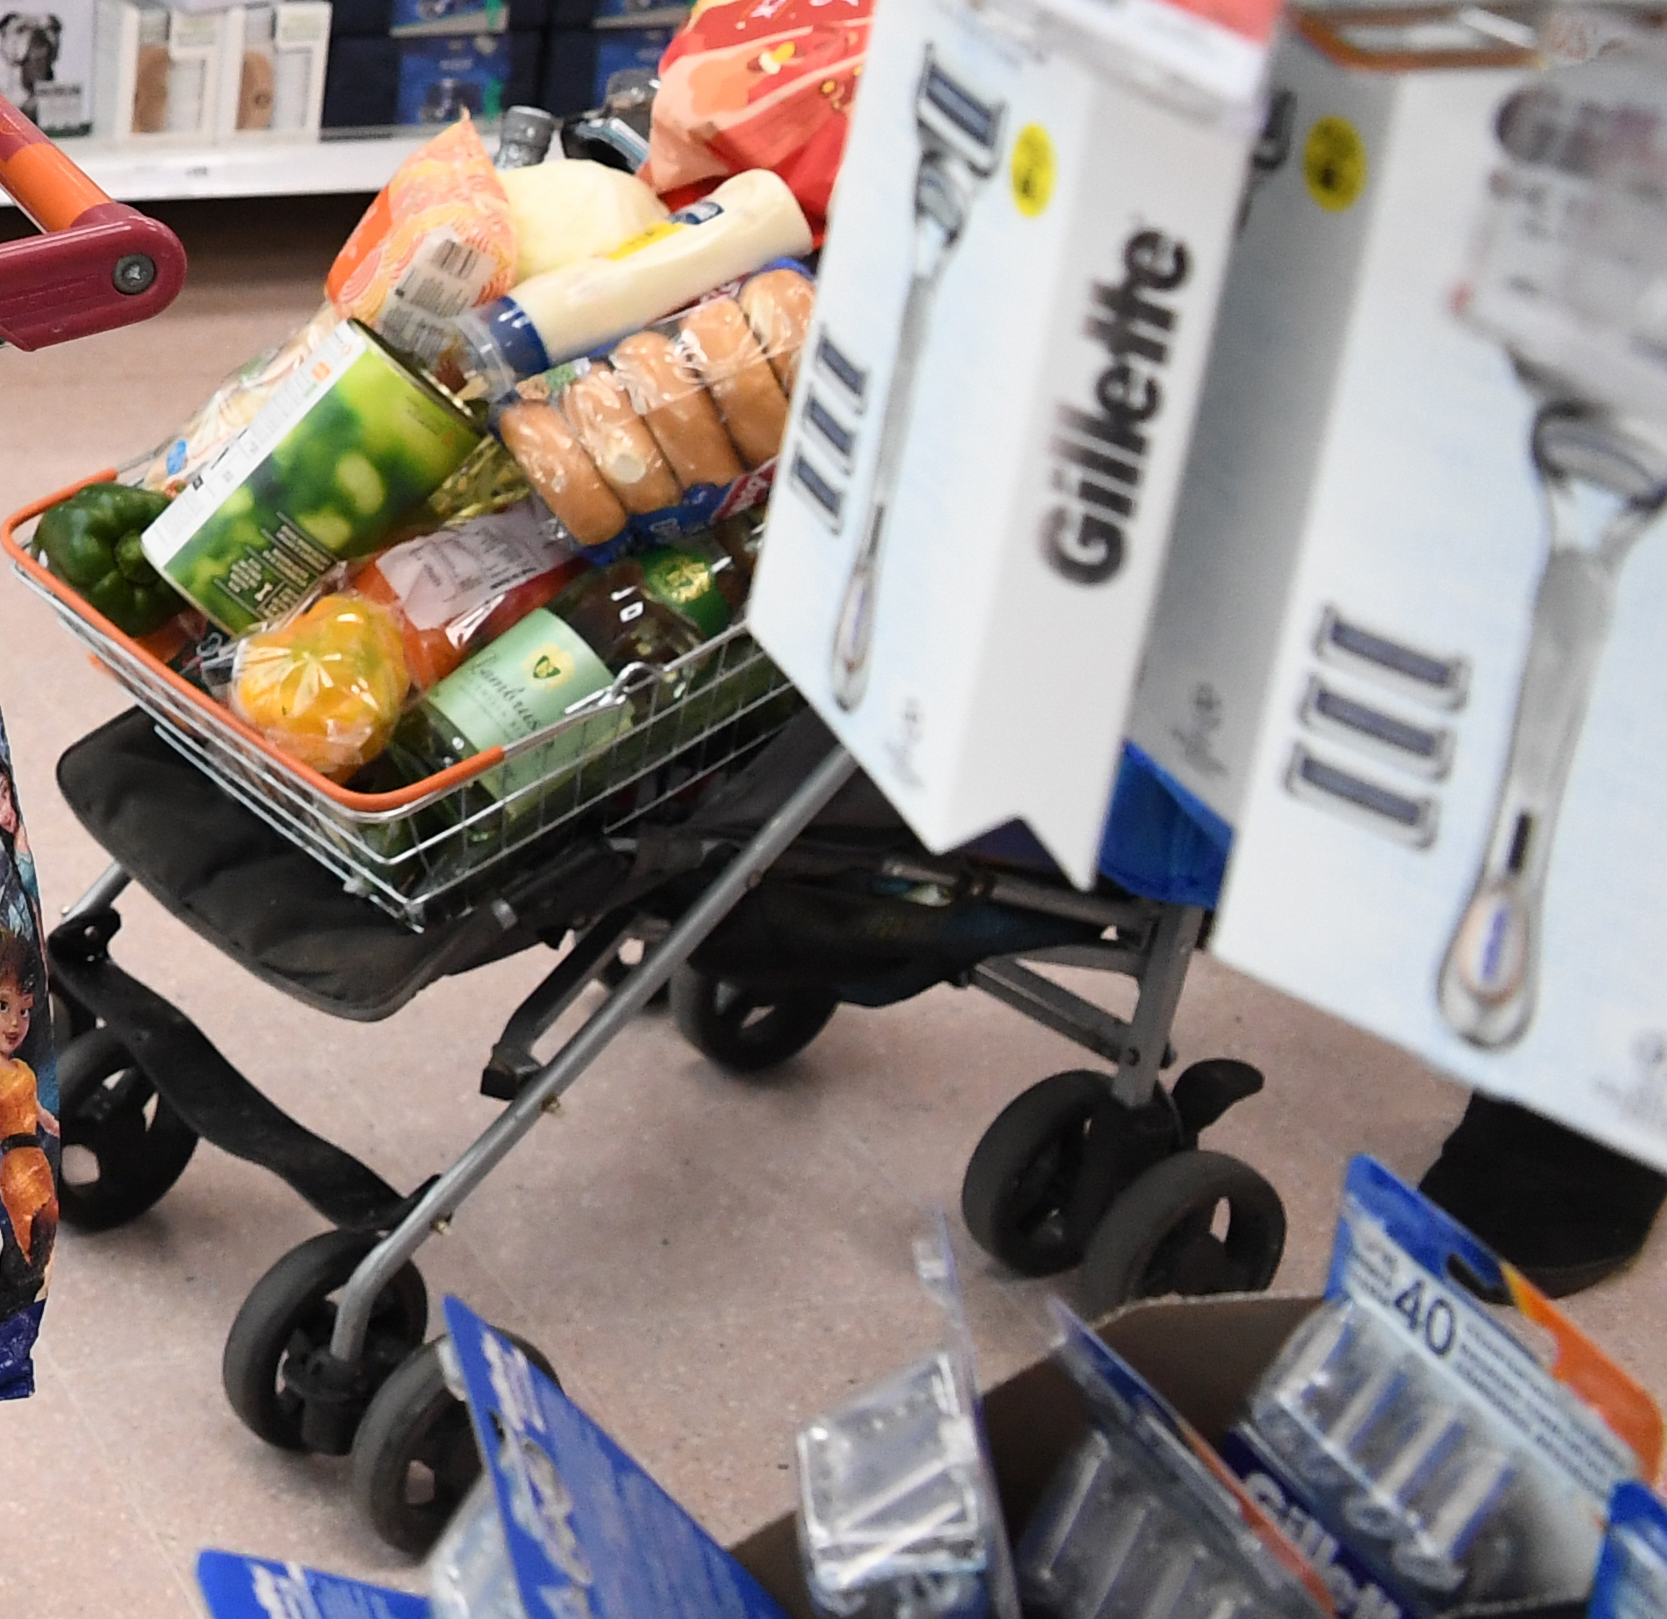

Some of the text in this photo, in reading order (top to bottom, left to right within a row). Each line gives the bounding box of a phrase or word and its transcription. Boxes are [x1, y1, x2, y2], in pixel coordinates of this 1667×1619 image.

[1032, 225, 1194, 588] Gillette
[467, 653, 542, 732] Lambrus
[1394, 1279, 1457, 1358] 40
